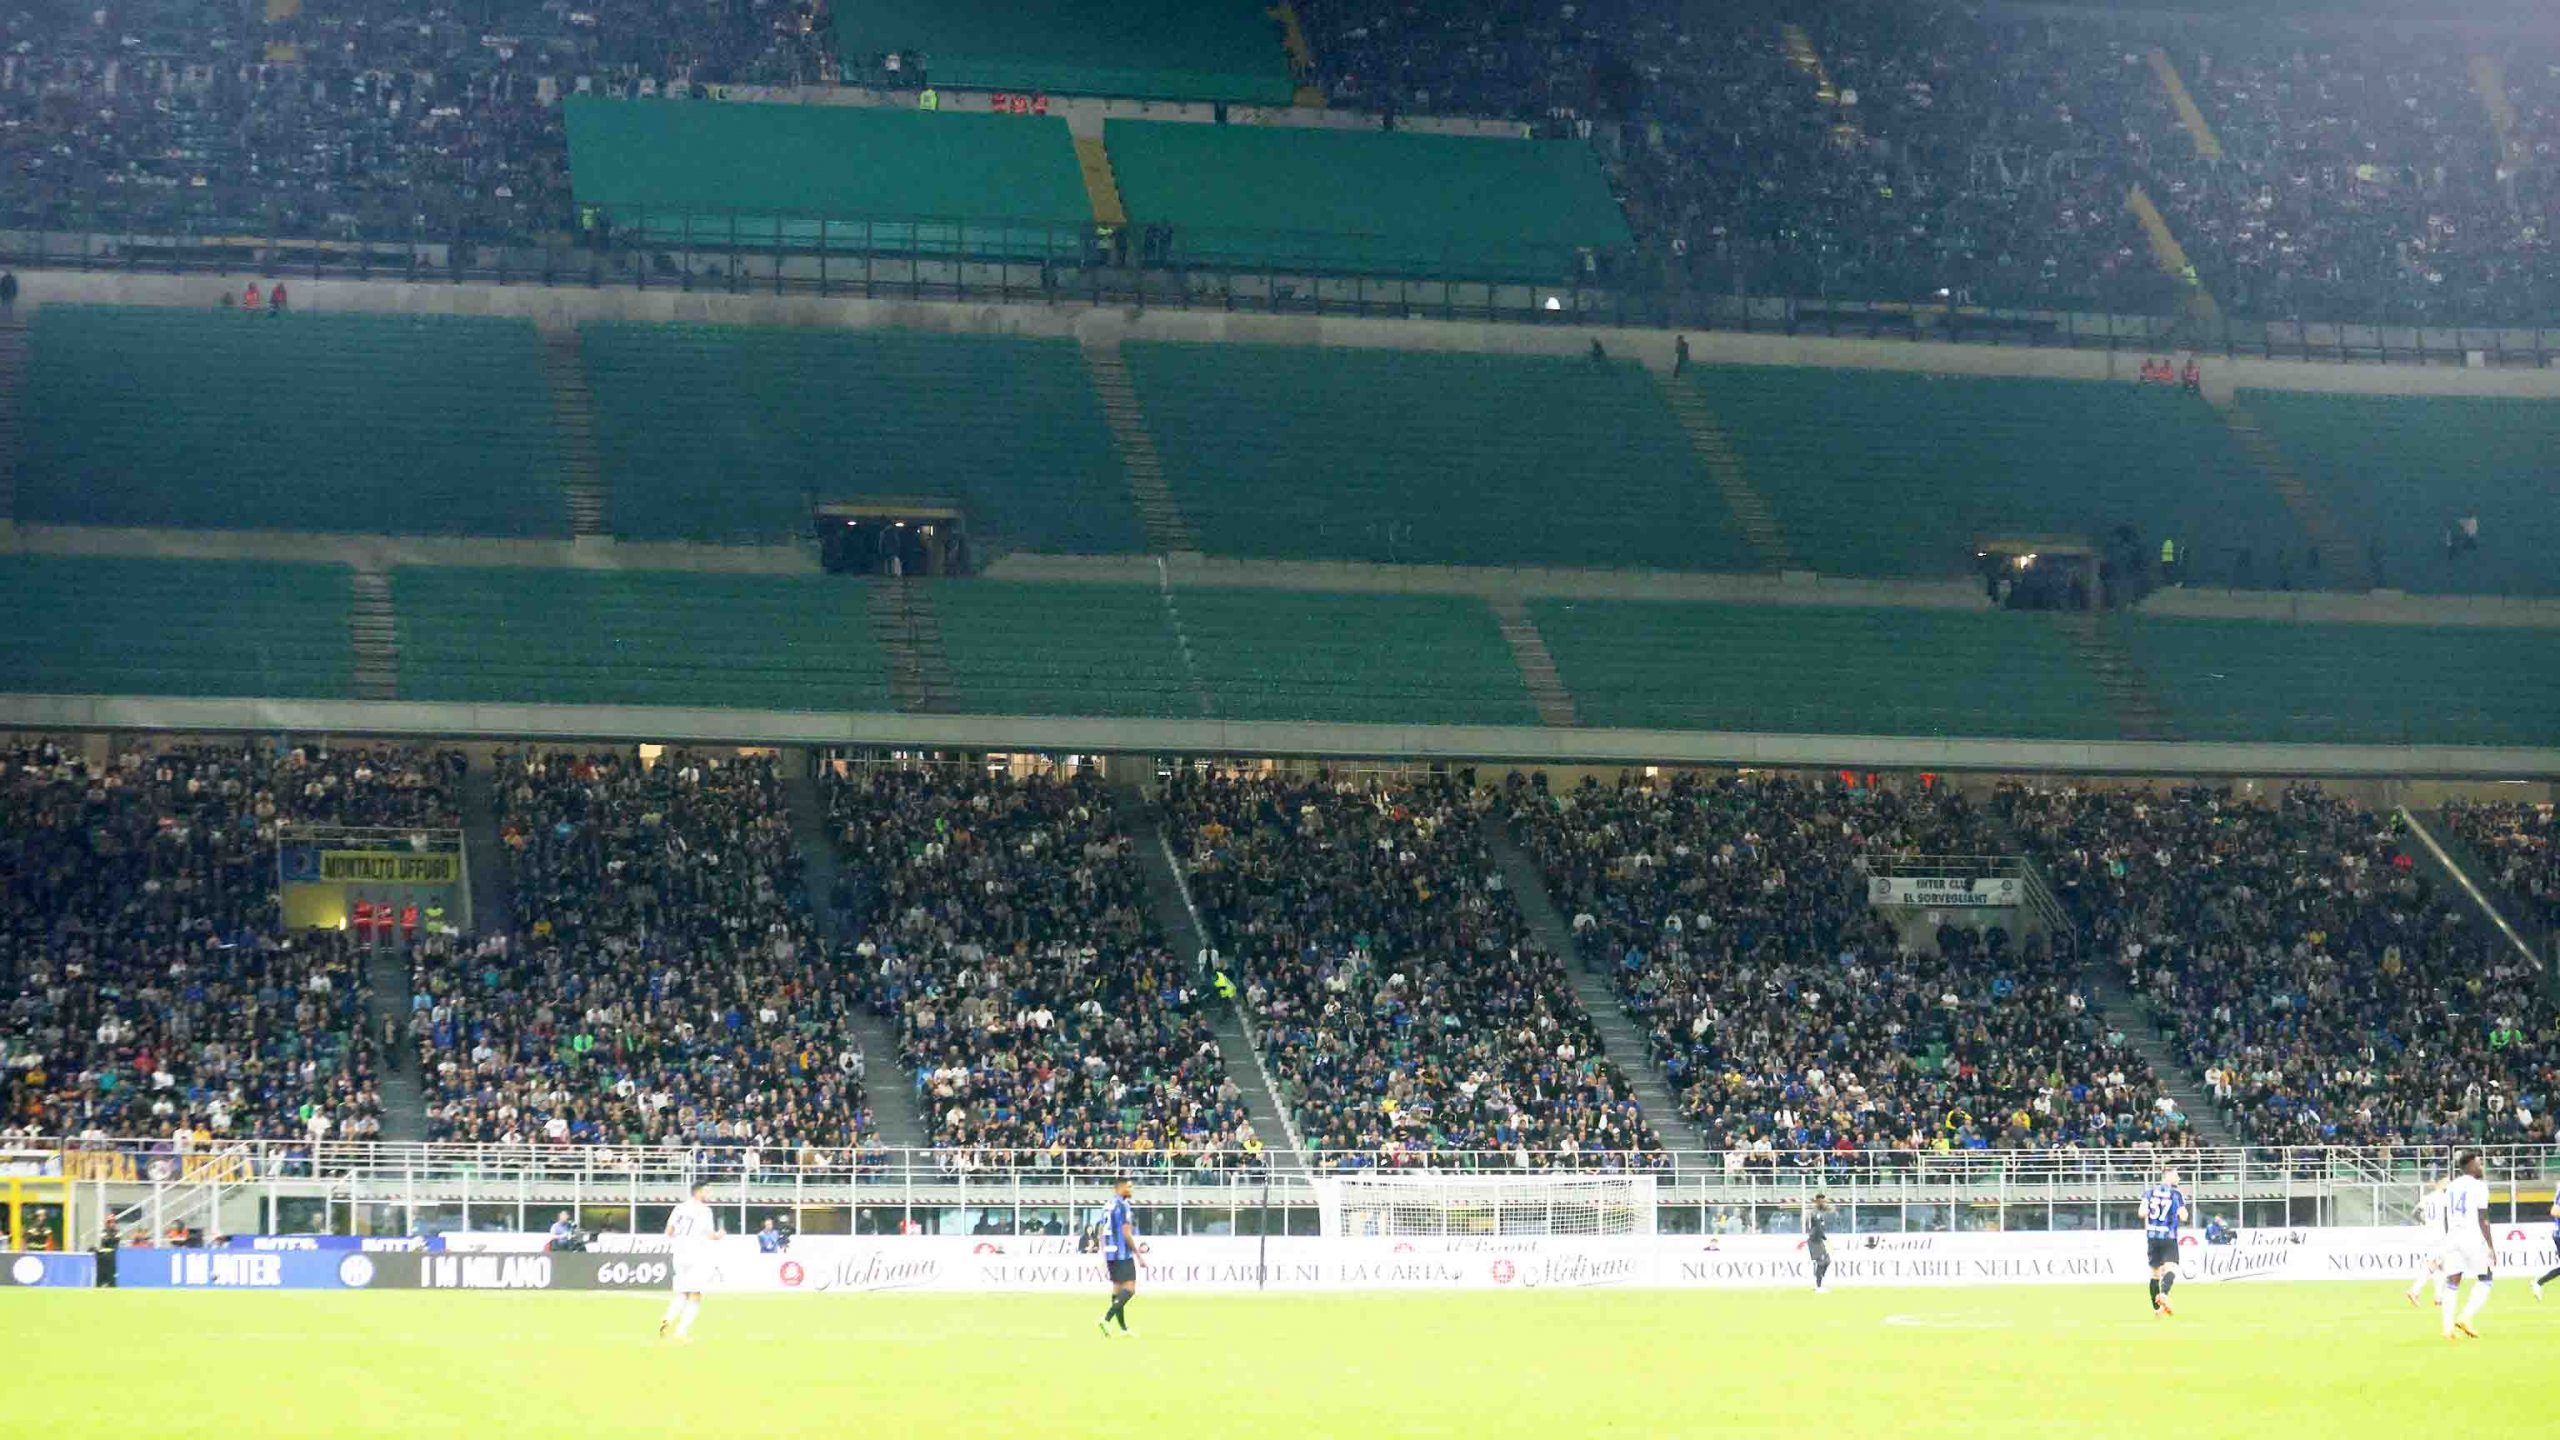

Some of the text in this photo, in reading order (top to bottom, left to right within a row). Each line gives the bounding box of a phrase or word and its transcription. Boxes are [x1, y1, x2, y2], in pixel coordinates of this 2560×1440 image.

[1917, 879, 1972, 890] INTER CLU
[1904, 893, 1915, 904] EL
[2149, 1197, 2173, 1221] 37
[2450, 1191, 2467, 1217] 14
[462, 1256, 551, 1288] MILANO
[598, 1262, 668, 1284] 60:09
[816, 1251, 943, 1291] Molisana
[982, 1264, 1070, 1282] NUOVO
[1681, 1261, 1764, 1280] NUOVO
[1834, 1258, 1967, 1279] RICICLABILE
[1974, 1258, 2041, 1277] NELLA
[2047, 1257, 2115, 1276] CARTA
[2182, 1247, 2288, 1281] Molisana
[2328, 1253, 2403, 1272] NUOVO
